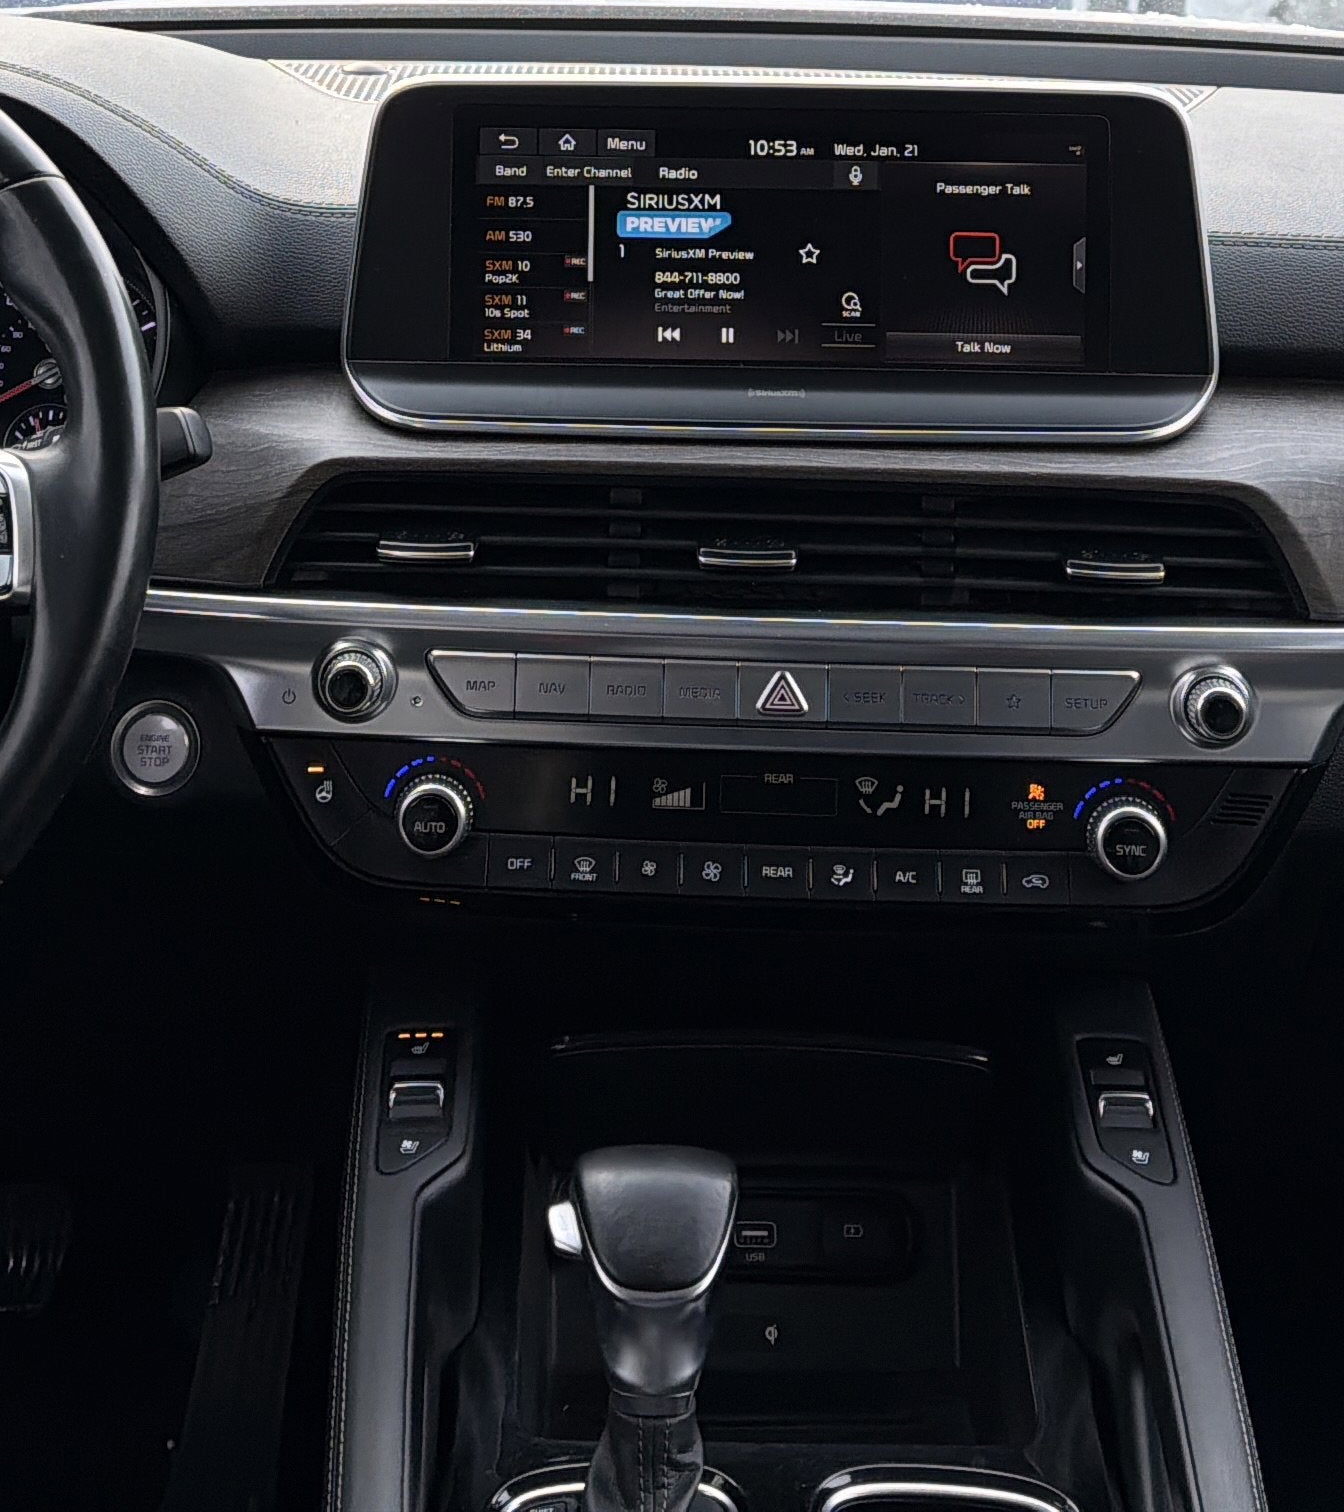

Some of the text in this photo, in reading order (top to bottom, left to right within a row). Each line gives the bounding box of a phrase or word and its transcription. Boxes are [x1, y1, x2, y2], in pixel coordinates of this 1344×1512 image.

[606, 137, 646, 152] Menu
[748, 139, 816, 157] 10:53 AM
[904, 145, 918, 157] 21
[495, 165, 528, 177] Band
[546, 166, 633, 179] Enter Channel
[659, 167, 698, 180] Radio
[936, 182, 1032, 197] Passenger Talk
[486, 196, 534, 208] FM 87.5
[626, 192, 721, 210] SIRIUSXM
[626, 216, 722, 233] PREVIEW
[486, 231, 532, 242] AM 530
[655, 248, 754, 261] SiriusXM Preview
[485, 260, 530, 272] SXM 10
[485, 273, 519, 284] Pop2K
[654, 272, 741, 285] 844-711-8800
[484, 294, 527, 306] SXM 11
[655, 288, 745, 300] Great Offer Now!
[504, 308, 531, 319] Spot
[654, 303, 732, 314] Entertainment
[484, 329, 532, 341] SXM 34
[834, 331, 863, 343] Live
[484, 342, 523, 353] Lithium
[956, 341, 1012, 354] Talk Now
[465, 679, 497, 692] MAP
[537, 682, 566, 695] NAV
[606, 684, 646, 697] RADIO
[679, 686, 721, 699] MEDIA
[854, 692, 887, 704] SEEK
[913, 693, 953, 705] TRACK
[1065, 697, 1108, 709] SETUP
[140, 734, 170, 743] ENGINE
[137, 745, 173, 756] START
[140, 756, 170, 767] STOP
[764, 773, 794, 785] REAR
[1011, 801, 1064, 811] PASSENGER
[1018, 811, 1054, 821] AIR BAG
[413, 821, 446, 834] AUTO
[1026, 820, 1046, 830] OFF
[1115, 844, 1148, 857] SYNC
[506, 858, 532, 871] OFF
[570, 872, 598, 882] FRONT
[762, 867, 793, 878] REAR
[895, 872, 917, 884] A/C
[961, 885, 984, 894] REAR
[745, 1252, 766, 1263] USB
